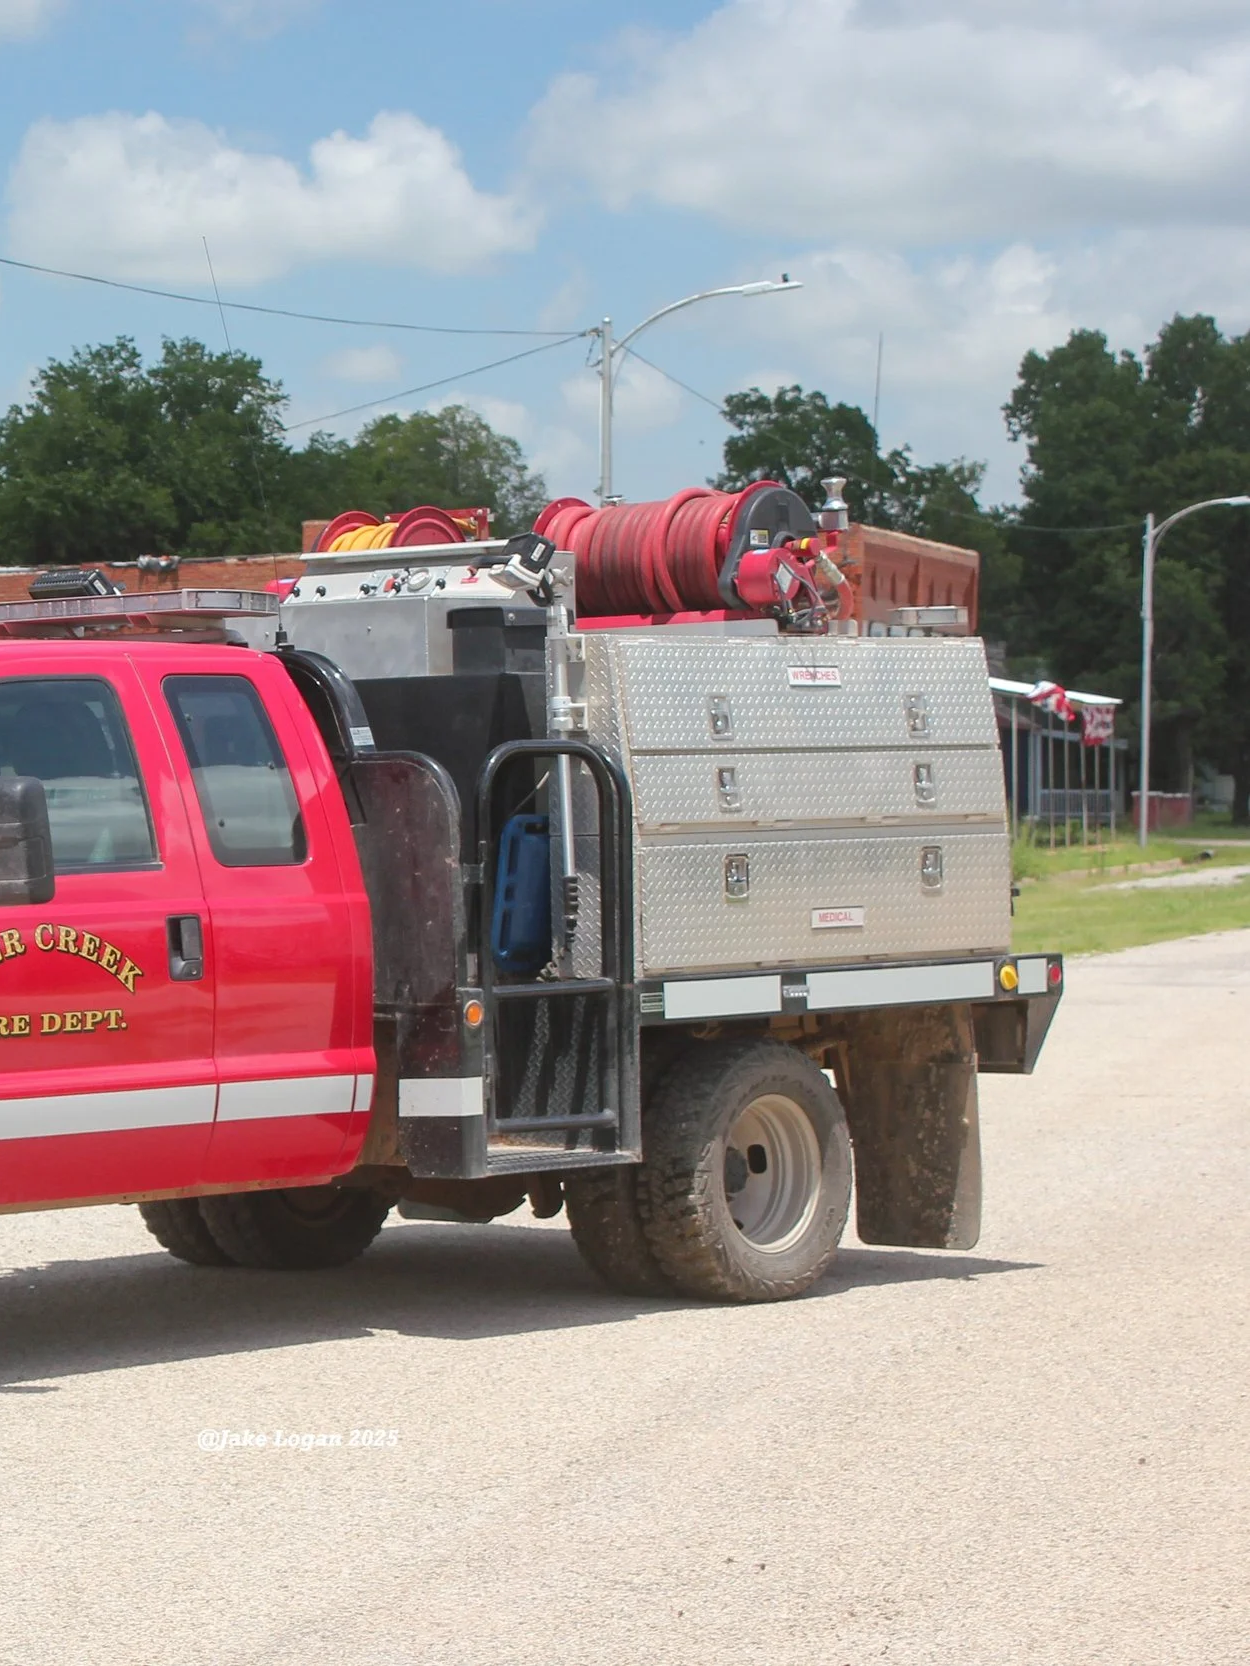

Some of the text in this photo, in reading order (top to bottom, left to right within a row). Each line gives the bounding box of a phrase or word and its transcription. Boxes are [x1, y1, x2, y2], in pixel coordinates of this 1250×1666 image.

[792, 670, 838, 681] WRENCHES
[818, 911, 854, 922] MEDICAL
[34, 922, 144, 994] CREEK
[40, 1009, 128, 1035] DEPT.
